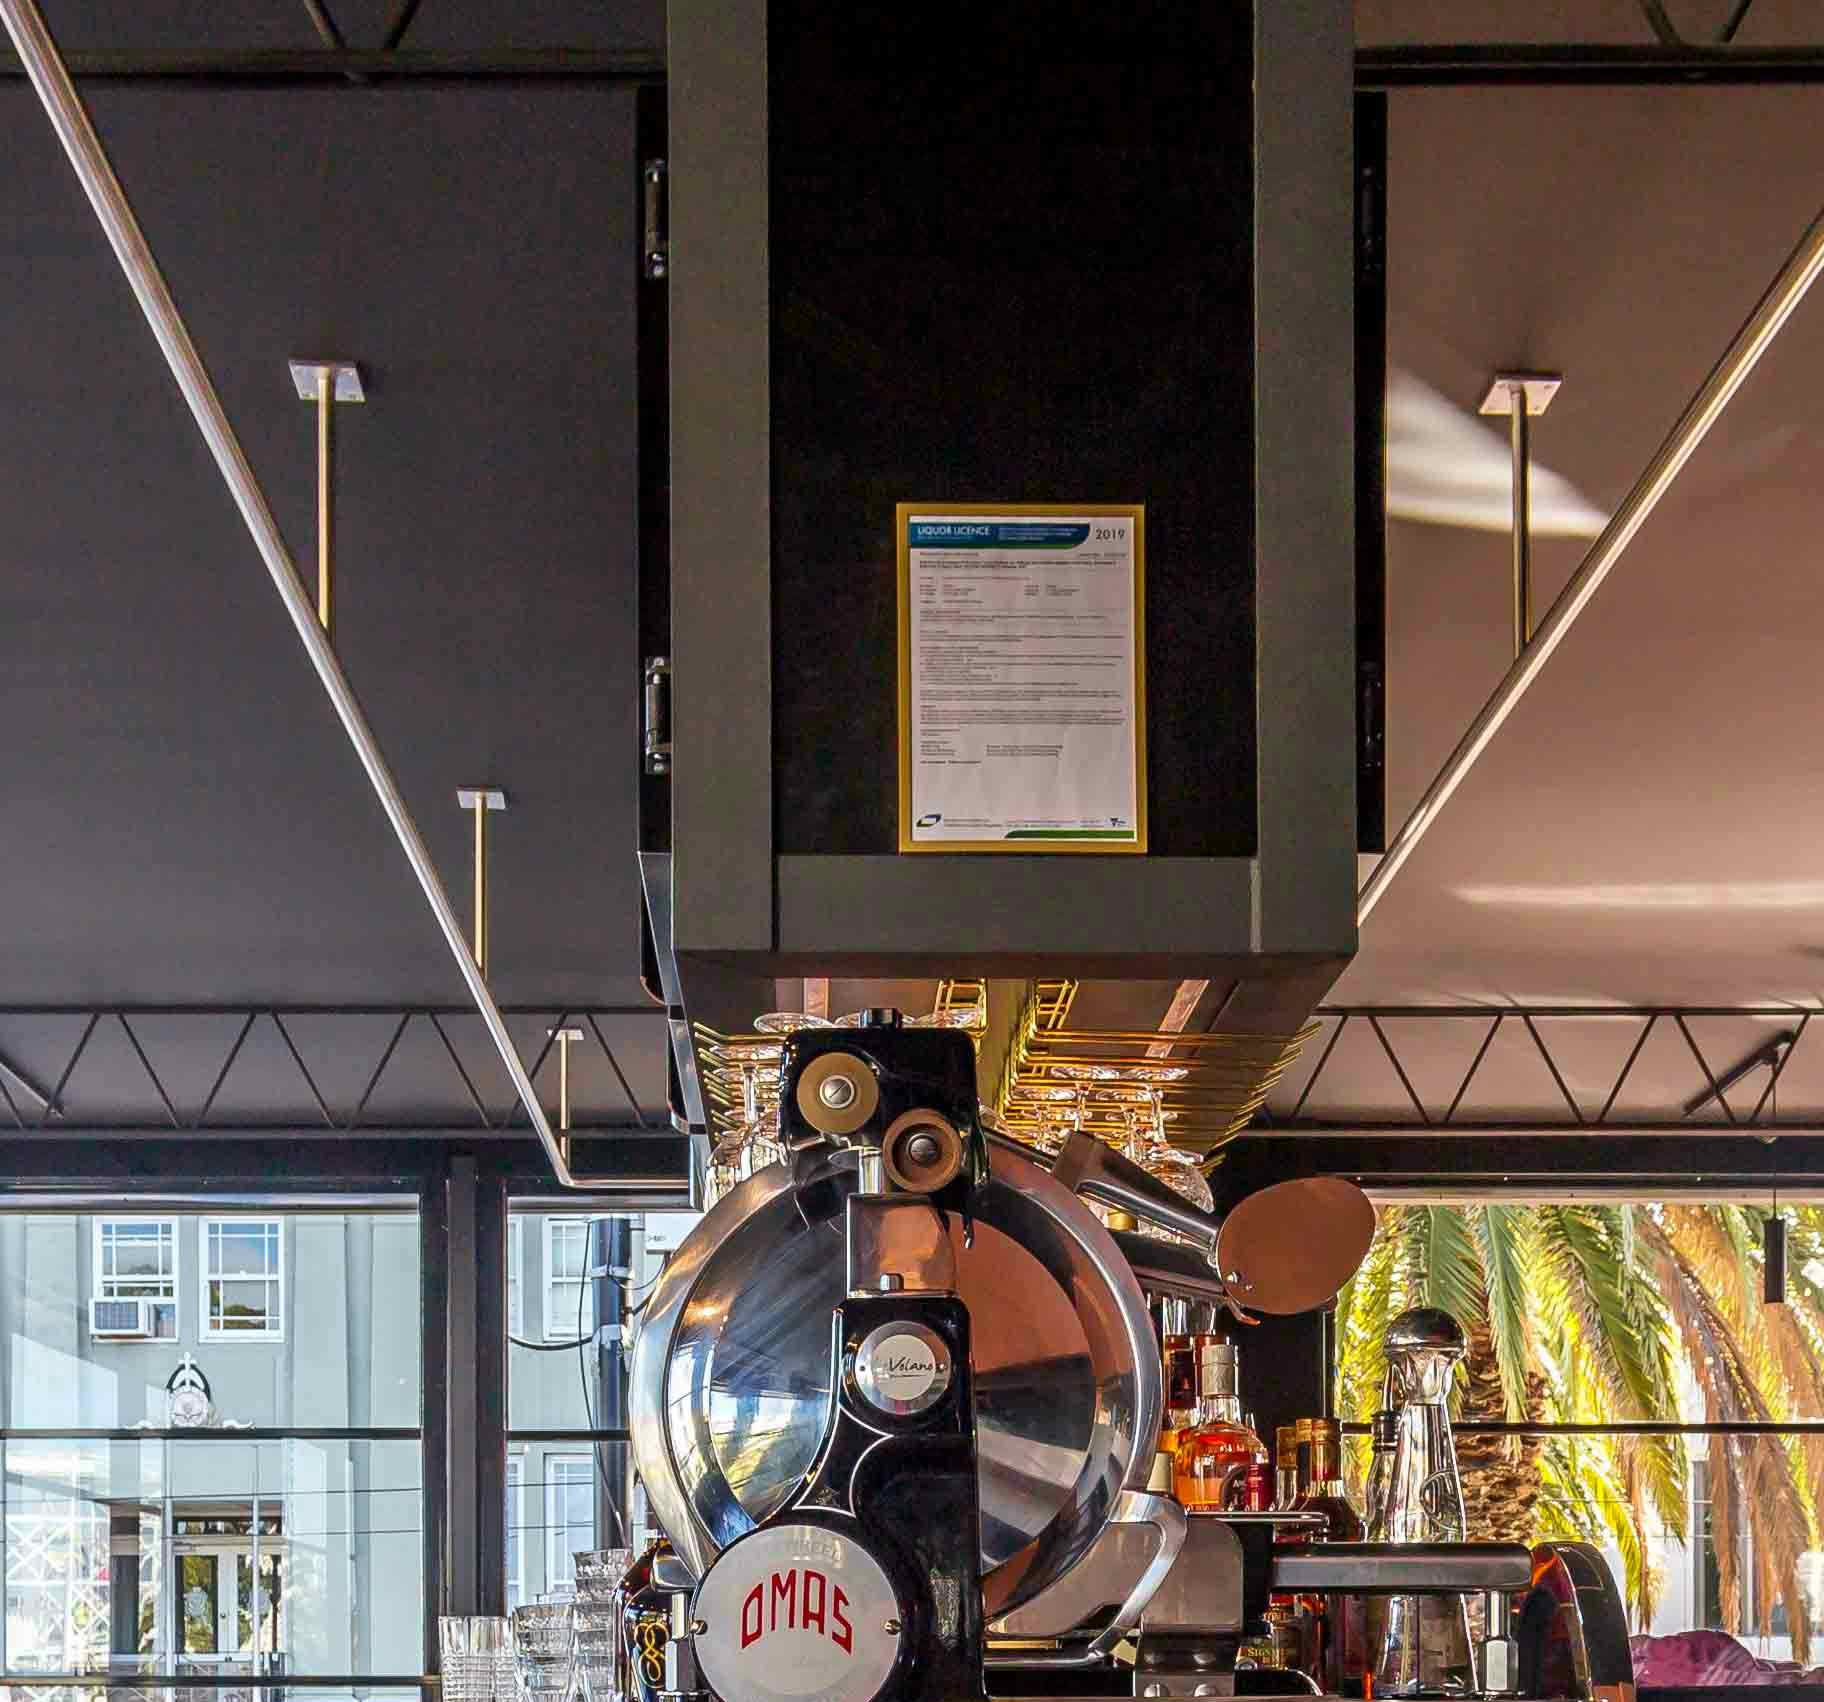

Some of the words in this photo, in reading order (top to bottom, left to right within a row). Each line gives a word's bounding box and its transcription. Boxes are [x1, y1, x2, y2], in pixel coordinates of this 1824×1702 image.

[917, 525, 952, 536] LIQUOR
[954, 525, 991, 536] LICENCE
[1095, 528, 1125, 540] 2019
[740, 1568, 854, 1656] OMAS
